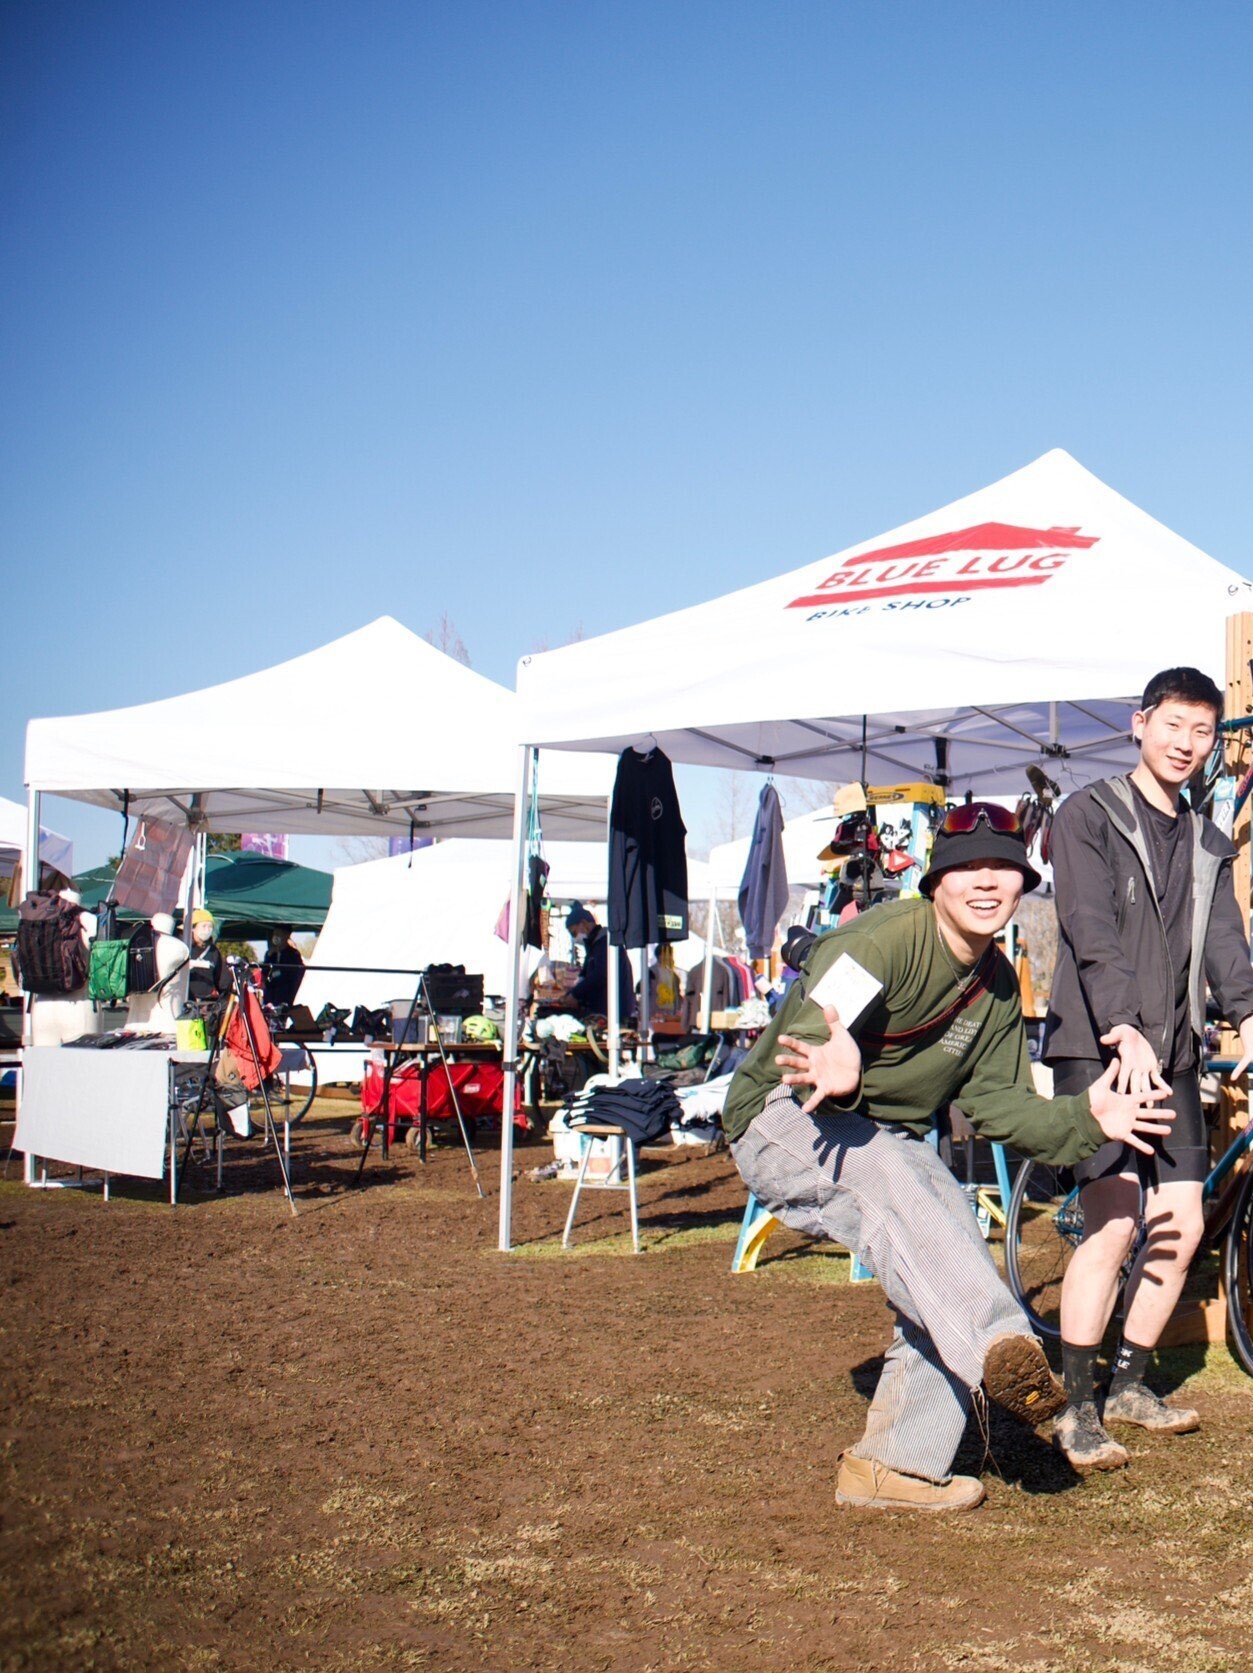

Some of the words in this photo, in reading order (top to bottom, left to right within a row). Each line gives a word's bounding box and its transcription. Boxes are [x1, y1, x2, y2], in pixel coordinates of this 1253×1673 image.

[816, 558, 948, 590] BLUE
[957, 553, 1071, 575] LUG
[806, 606, 872, 622] BIKE
[882, 597, 972, 611] SHOP
[963, 1019, 982, 1029] DEAT
